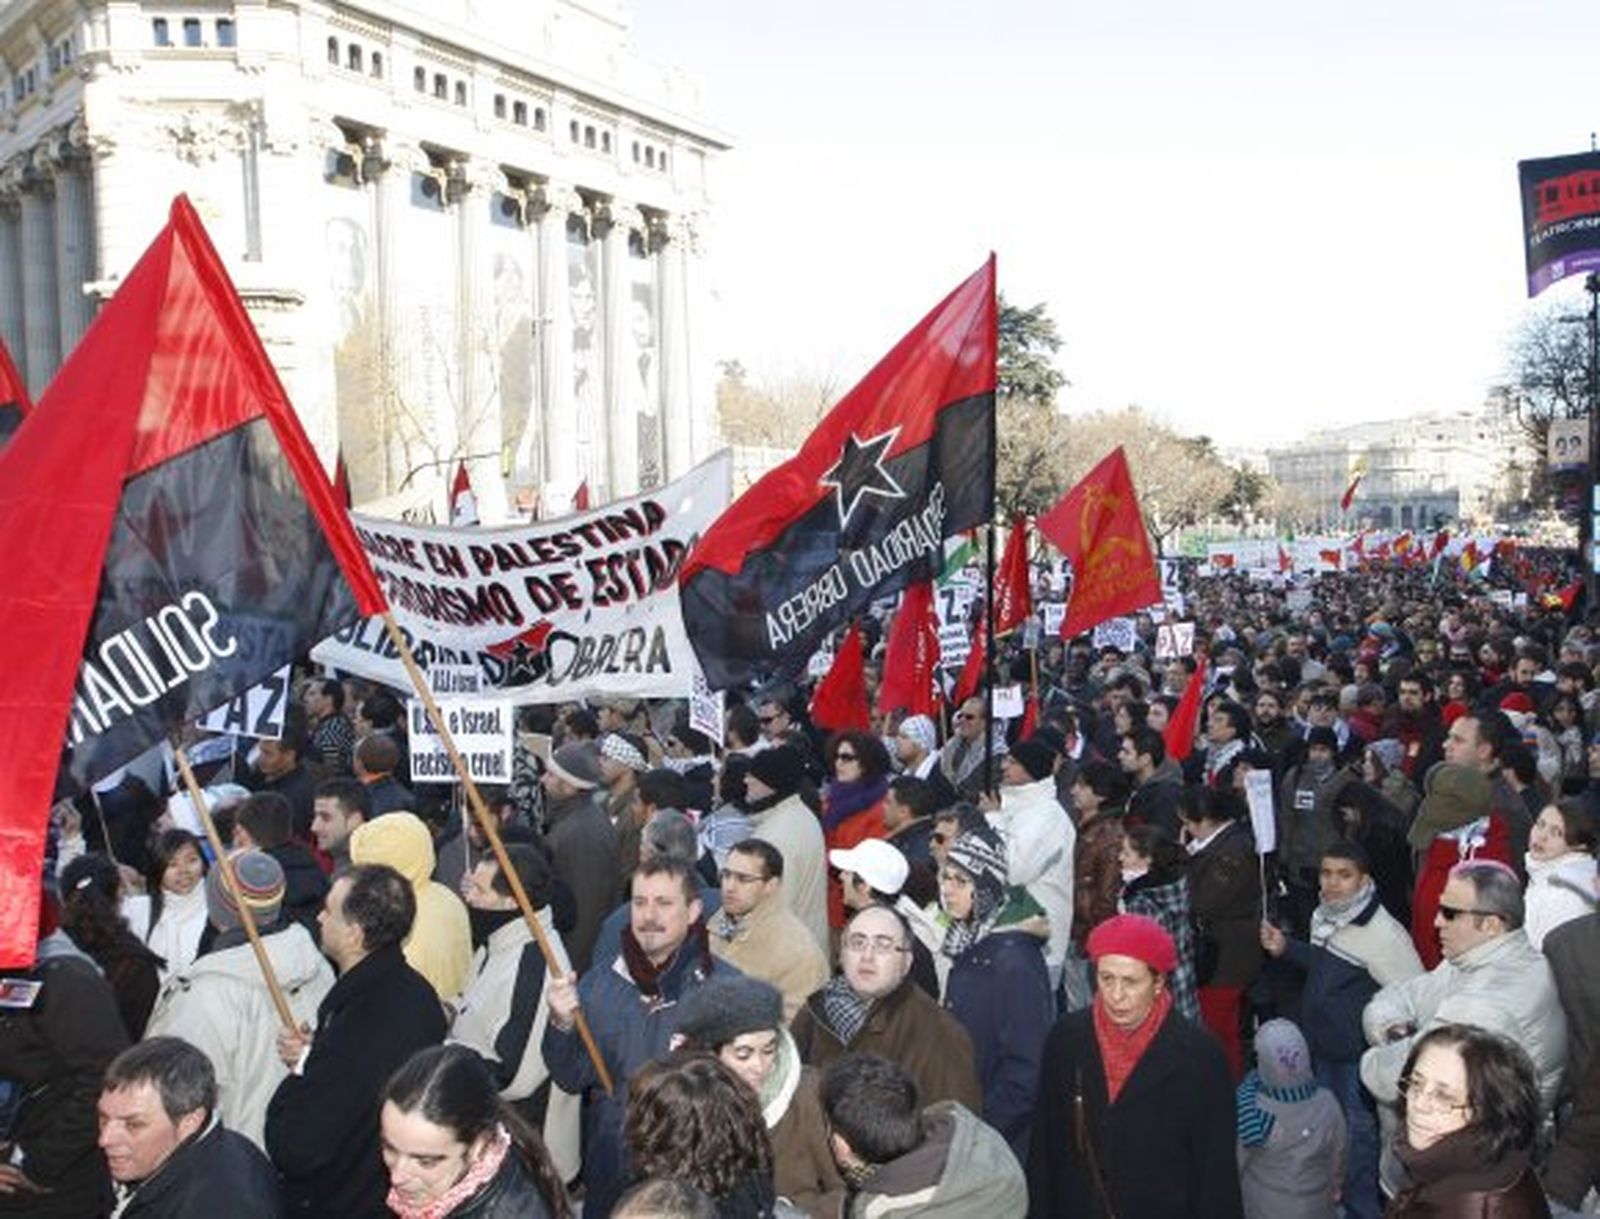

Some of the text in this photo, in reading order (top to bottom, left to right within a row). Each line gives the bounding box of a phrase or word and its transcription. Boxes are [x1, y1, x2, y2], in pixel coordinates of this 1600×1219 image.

[422, 541, 469, 578] EN
[468, 501, 666, 577] PALESTINA
[524, 570, 583, 615] DE
[546, 626, 671, 686] OBRERA
